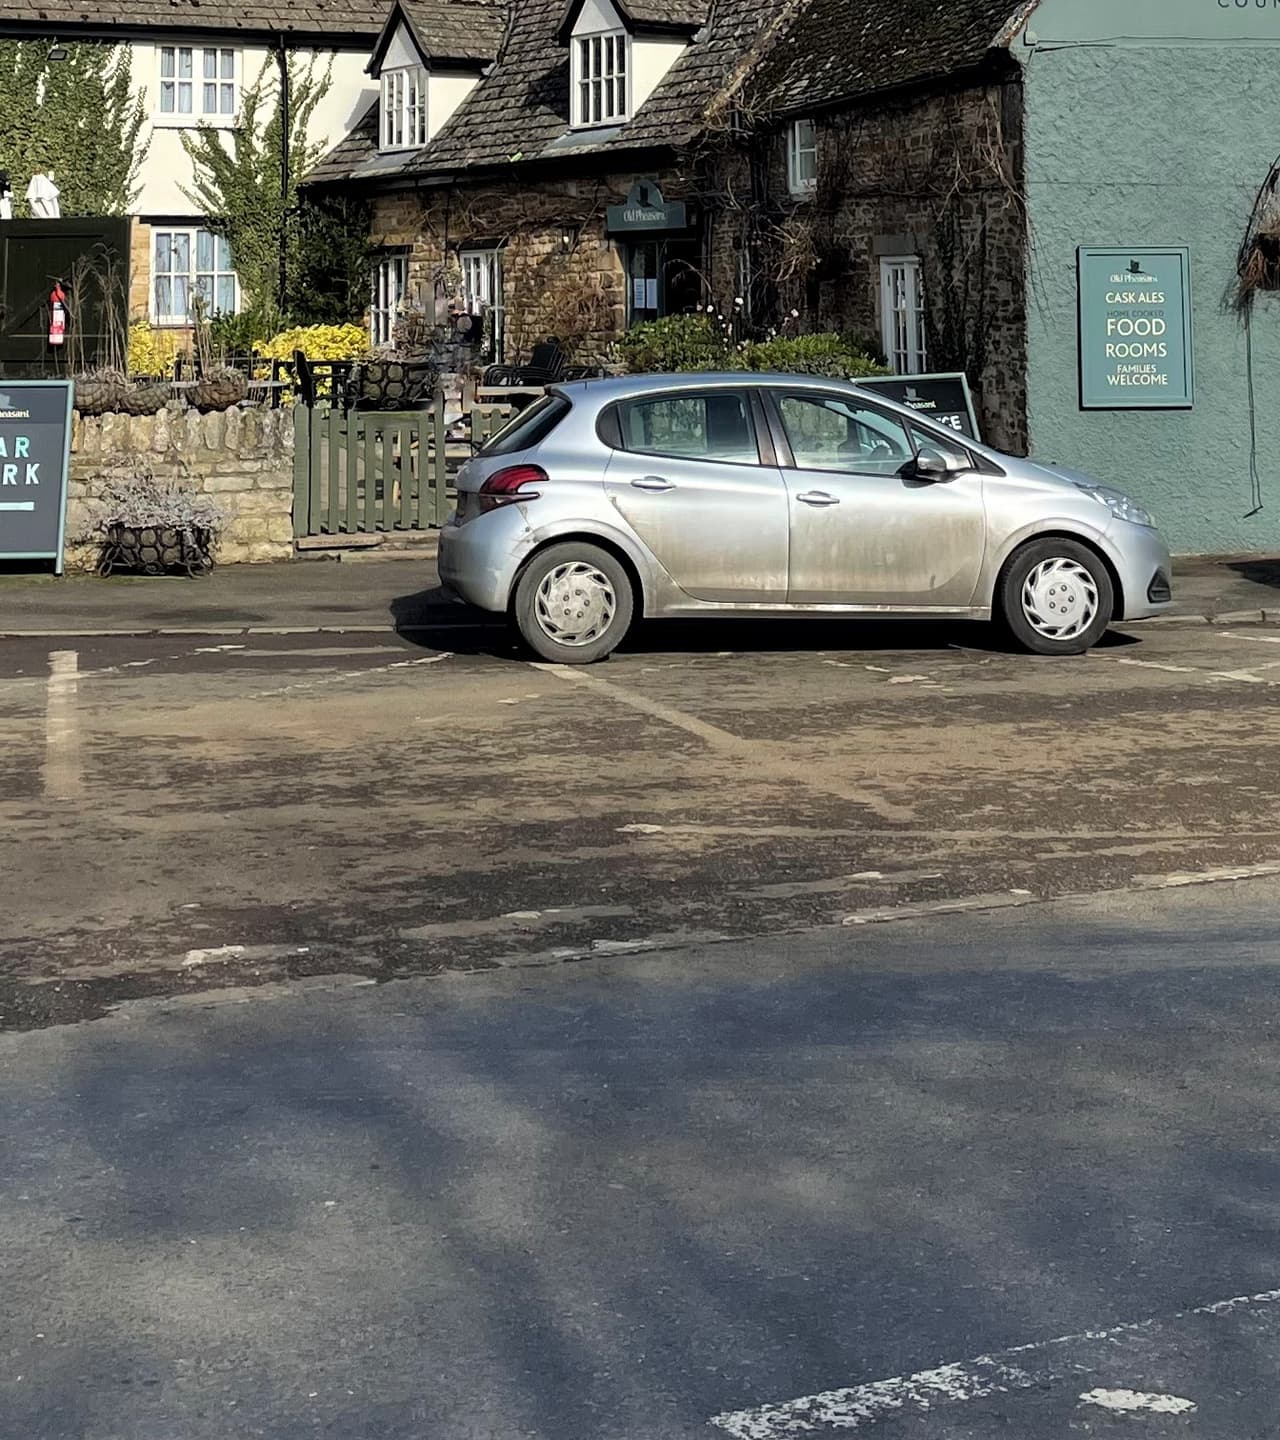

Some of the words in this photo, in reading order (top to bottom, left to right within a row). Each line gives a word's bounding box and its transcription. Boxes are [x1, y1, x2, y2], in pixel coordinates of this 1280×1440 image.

[1105, 292, 1136, 303] CASK
[1138, 292, 1165, 303] ALES
[1107, 318, 1166, 336] FOOD
[1106, 343, 1167, 358] ROOMS
[1117, 364, 1157, 374] FAMILIES
[1107, 374, 1168, 385] WELCOME
